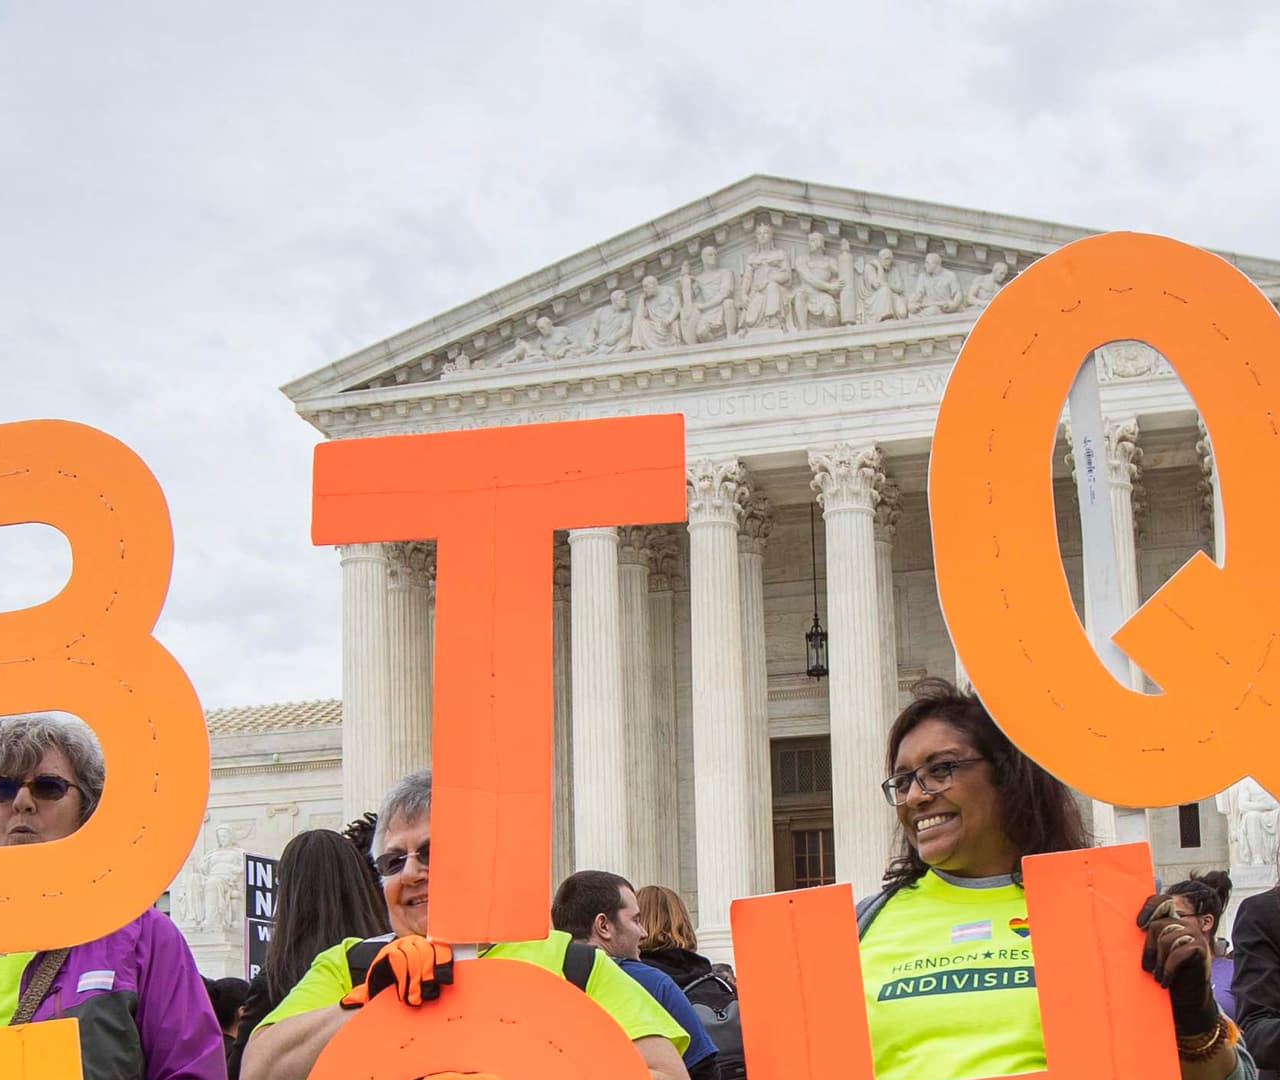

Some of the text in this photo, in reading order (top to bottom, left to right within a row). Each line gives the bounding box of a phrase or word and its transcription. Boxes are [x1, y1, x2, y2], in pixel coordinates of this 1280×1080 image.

[690, 390, 789, 418] JUSTICE
[802, 379, 889, 406] UNDER
[901, 374, 946, 396] LAW
[892, 952, 979, 975] HERNDON
[884, 969, 1030, 997] INDIVISIB
